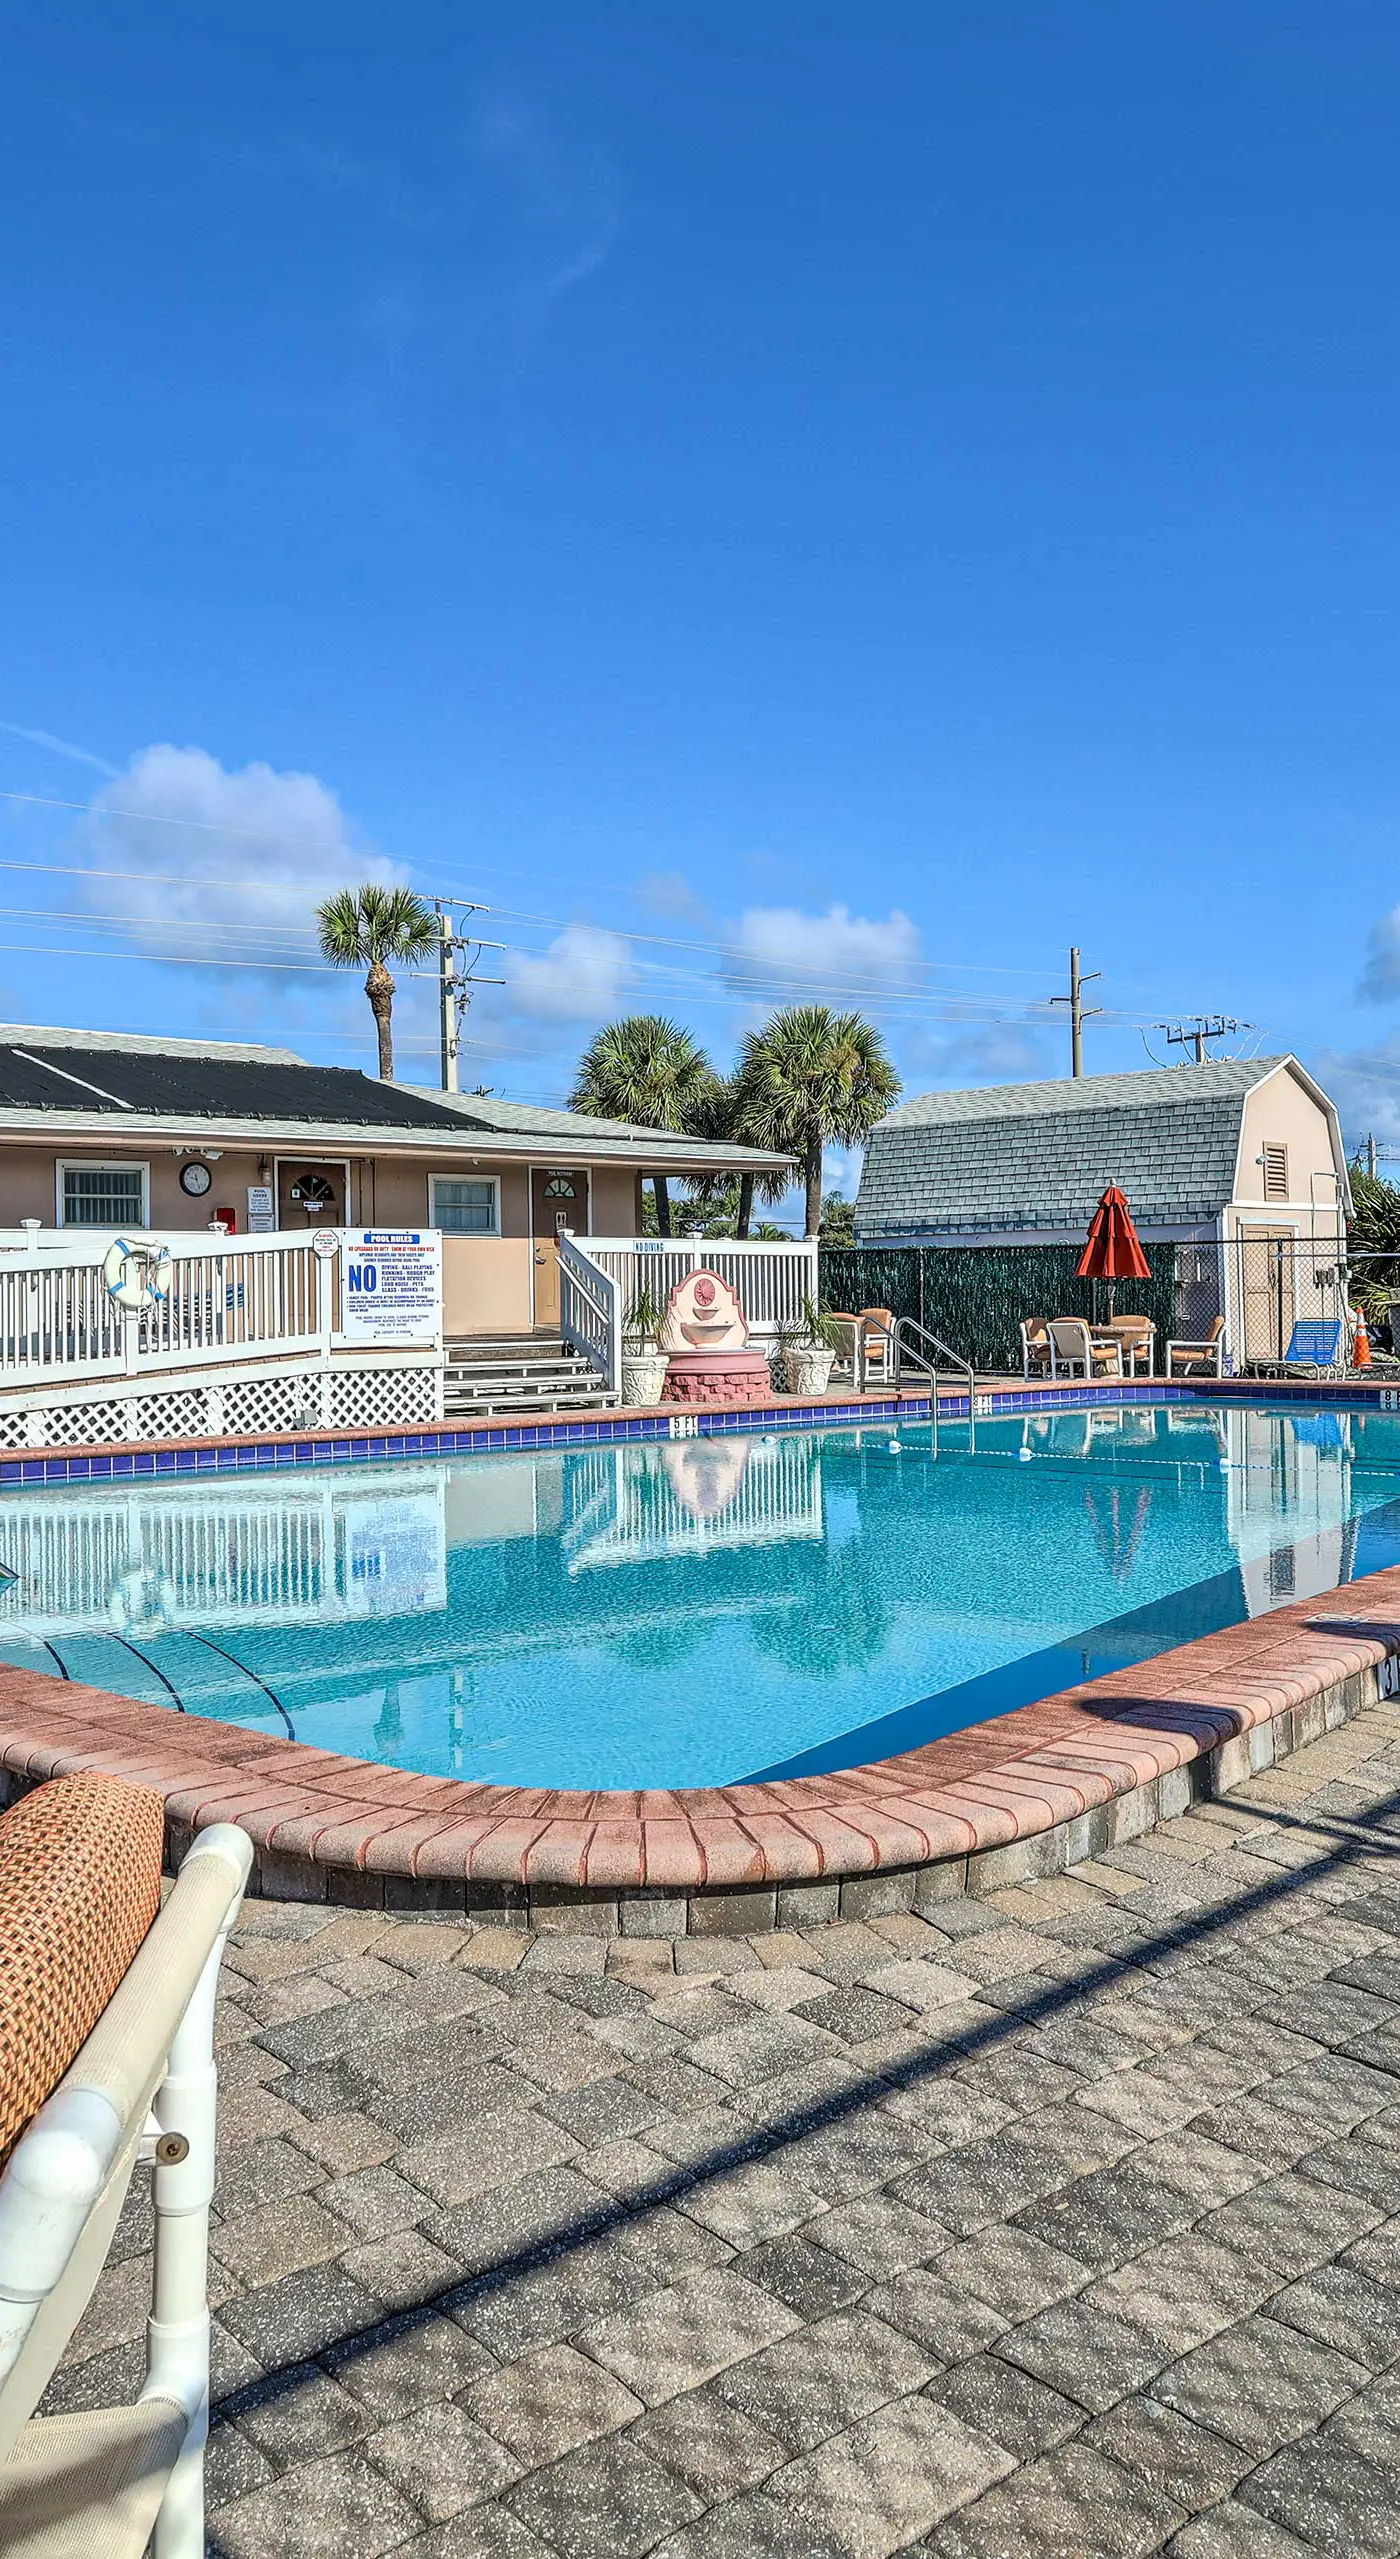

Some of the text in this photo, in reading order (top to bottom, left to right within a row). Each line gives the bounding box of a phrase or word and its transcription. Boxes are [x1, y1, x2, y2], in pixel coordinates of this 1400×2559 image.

[636, 1242, 664, 1252] NO DIVING
[348, 1264, 377, 1292] NO
[973, 1395, 978, 1406] 8
[1385, 1390, 1391, 1401] 8
[674, 1415, 696, 1429] 5 FT
[1384, 1658, 1392, 1695] 3
